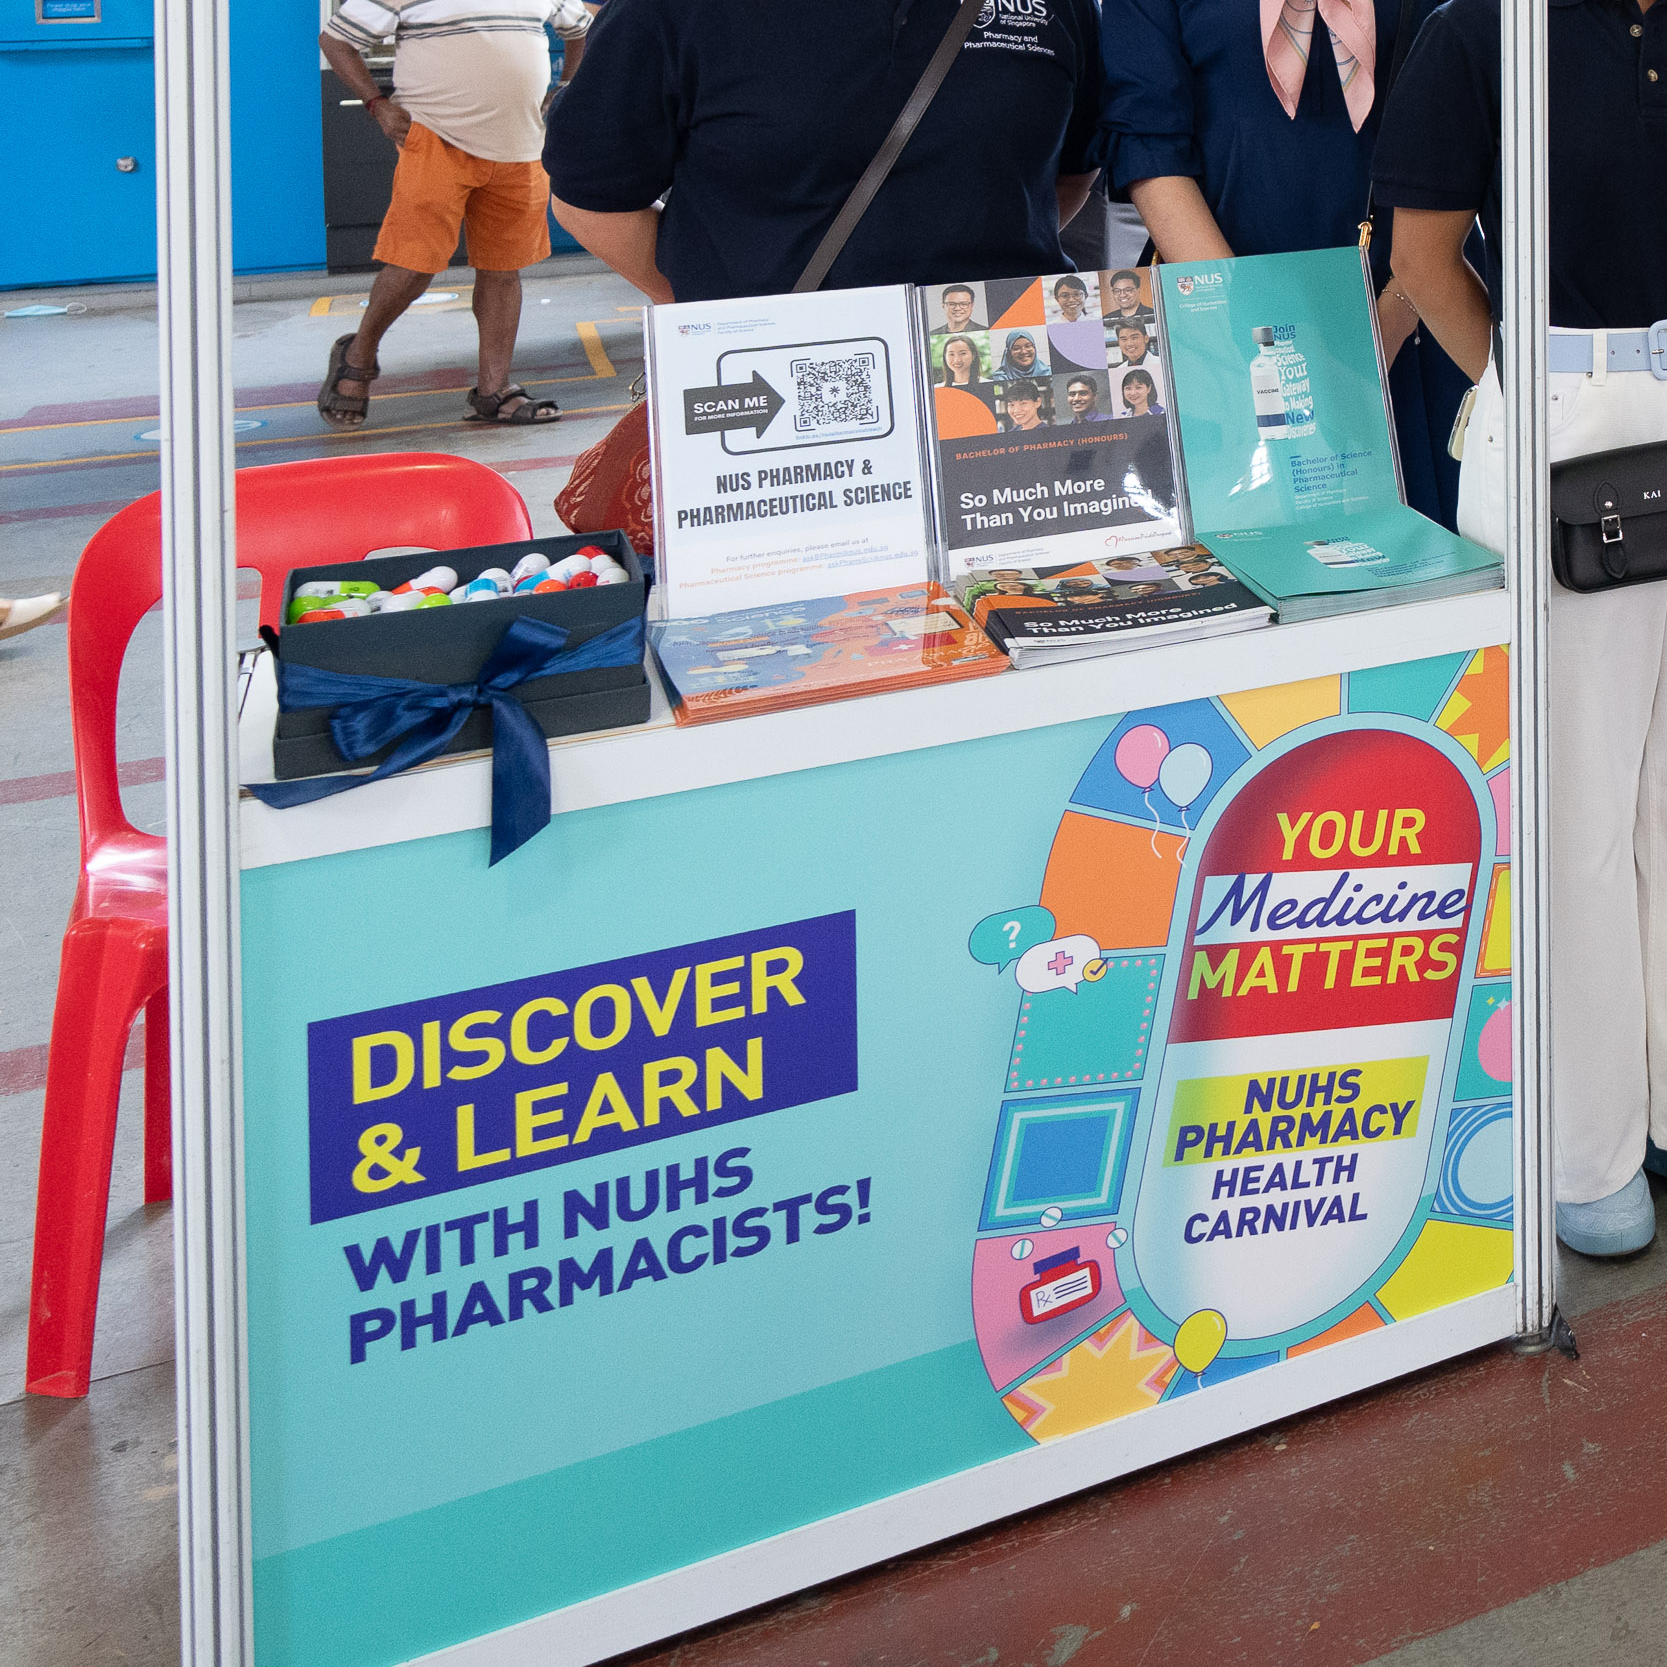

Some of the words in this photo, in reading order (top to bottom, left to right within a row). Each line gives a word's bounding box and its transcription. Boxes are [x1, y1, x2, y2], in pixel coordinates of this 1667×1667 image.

[1006, 20, 1036, 28] Singapore
[1024, 15, 1048, 26] University
[983, 31, 1022, 43] Pharmacy
[1024, 35, 1038, 43] and
[963, 41, 1025, 51] Pharmaceutical
[1027, 44, 1055, 56] Sciences
[1194, 273, 1223, 285] NUS
[691, 323, 711, 331] NUS
[1272, 324, 1296, 334] Join
[1273, 332, 1297, 341] NUS
[1276, 352, 1306, 367] Science
[1280, 378, 1310, 397] Gateway
[693, 397, 740, 414] SCAN
[743, 395, 768, 408] ME
[1290, 395, 1314, 410] Making
[707, 413, 726, 421] MORE
[727, 408, 769, 418] INFORMATION
[1285, 410, 1315, 425] New
[955, 446, 1006, 460] BACHELOR
[1008, 445, 1020, 455] OF
[1023, 439, 1075, 452] PHARMACY
[1077, 432, 1128, 446] (HONOURS)
[1290, 457, 1328, 468] Bachelor
[1340, 450, 1373, 460] Science
[716, 471, 752, 494] NUS
[757, 459, 855, 489] PHARMACY
[861, 459, 873, 475] &
[1291, 463, 1335, 477] (Honours)
[1336, 462, 1345, 470] in
[1293, 469, 1358, 485] Pharmaceutical
[960, 492, 987, 509] So
[993, 483, 1049, 505] Much
[1054, 478, 1105, 497] More
[1294, 483, 1327, 493] Science
[1643, 489, 1661, 500] KAI
[677, 492, 838, 529] PHARMACEUTICAL
[843, 480, 913, 507] SCIENCE
[961, 508, 1013, 531] Than
[1018, 503, 1058, 523] You
[726, 555, 738, 563] For
[739, 551, 765, 562] further
[766, 547, 803, 560] enquiries,
[805, 541, 829, 552] please
[830, 539, 849, 549] email
[976, 554, 994, 563] NUS
[710, 563, 751, 575] Pharmacy
[679, 573, 742, 589] Pharmaceutical
[744, 569, 776, 580] Science
[1026, 625, 1084, 634] Than
[1093, 619, 1133, 630] You
[1138, 602, 1238, 624] Imagined
[1059, 615, 1121, 628] Much
[1123, 607, 1183, 618] More
[1276, 808, 1426, 860] YOUR
[1195, 871, 1472, 936] Medicine
[1187, 933, 1460, 1000] MATTERS
[352, 945, 807, 1105] DISCOVER
[1243, 1068, 1363, 1115] NUHS
[351, 1122, 427, 1194] &
[456, 1036, 764, 1172] LEARN
[1173, 1099, 1416, 1162] PHARMACY
[1211, 1152, 1359, 1200] HEALTH
[343, 1198, 539, 1293] WITH
[563, 1146, 754, 1239] NUHS
[1183, 1192, 1368, 1244] CARNIVAL
[350, 1176, 873, 1365] PHARMACISTS!
